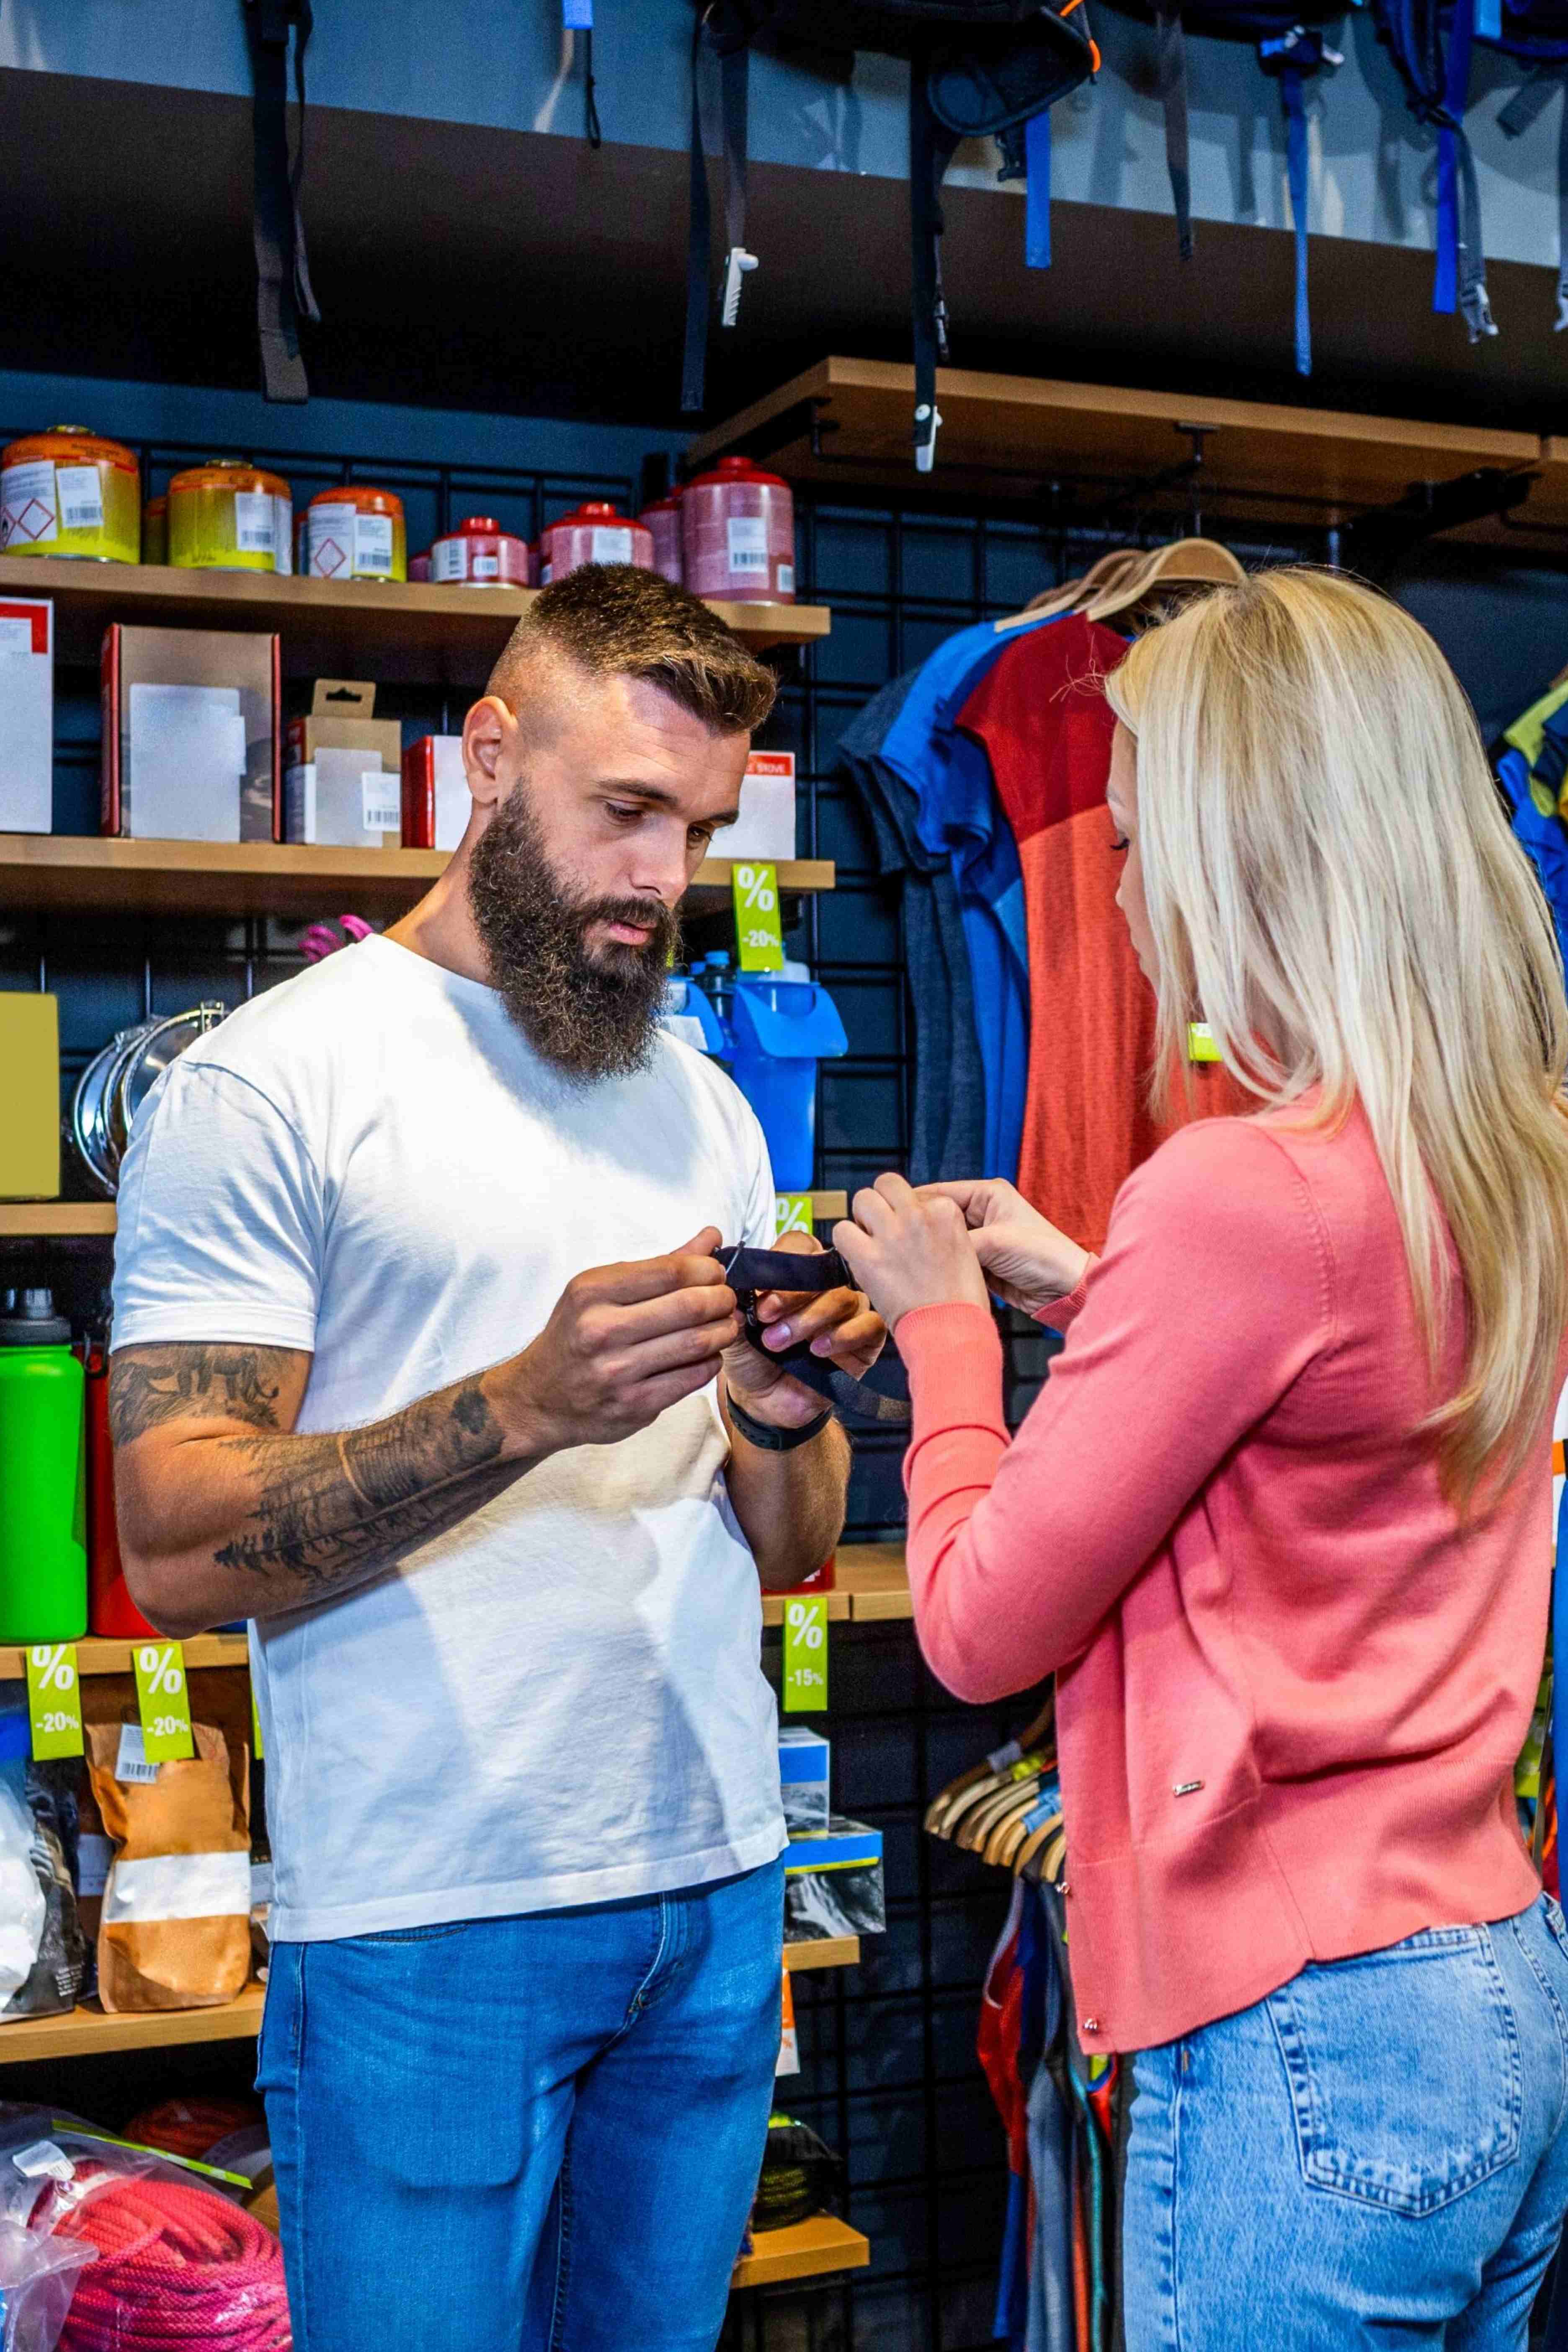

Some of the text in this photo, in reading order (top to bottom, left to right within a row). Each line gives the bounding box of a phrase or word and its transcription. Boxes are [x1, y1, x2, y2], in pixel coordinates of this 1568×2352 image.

[737, 866, 775, 912] %
[742, 929, 779, 948] -20%
[788, 1603, 823, 1649] %
[32, 1643, 75, 1690] %
[139, 1646, 182, 1694] %
[787, 1668, 824, 1687] -15%
[35, 1711, 80, 1733] -20%
[146, 1715, 189, 1737] -20%
